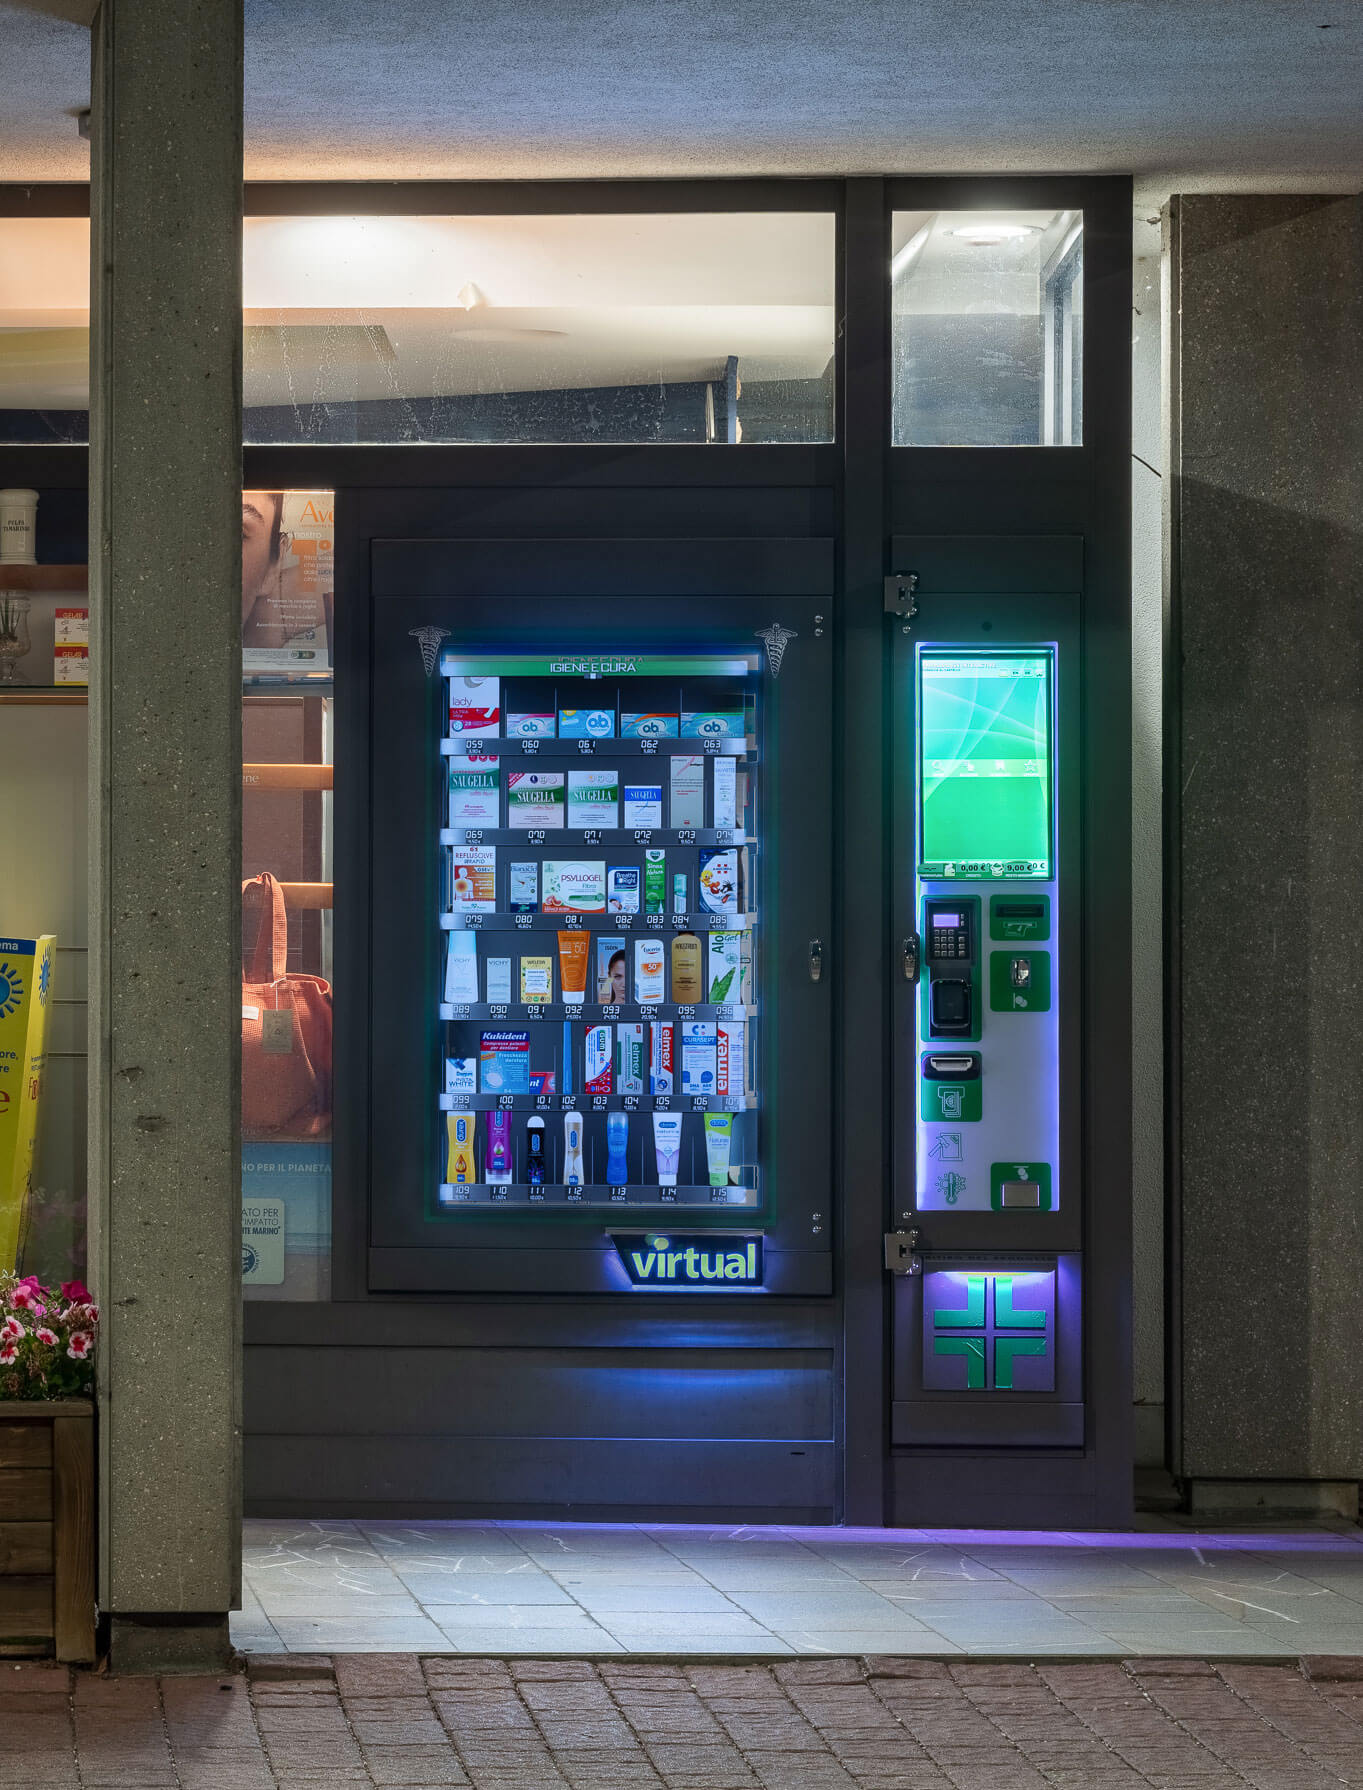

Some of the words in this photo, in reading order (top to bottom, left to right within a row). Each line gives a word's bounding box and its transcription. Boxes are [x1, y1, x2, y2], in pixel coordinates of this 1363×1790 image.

[550, 663, 588, 673] IGIENE
[591, 663, 599, 673] E
[601, 663, 636, 673] CURA
[453, 697, 472, 706] lady
[466, 740, 483, 748] 059
[522, 740, 539, 748] 060
[578, 740, 596, 748] 061
[641, 740, 658, 748] 062
[704, 740, 721, 748] 063
[453, 776, 494, 787] SAUGELLA
[517, 792, 555, 803] SAUGELLA
[574, 790, 612, 801] SAUGELLA
[465, 831, 483, 839] 069
[528, 831, 545, 839] 070
[584, 831, 602, 839] 071
[634, 831, 652, 839] 072
[678, 831, 696, 839] 073
[960, 864, 979, 872] 0,00
[561, 874, 603, 882] PSYLLOGEL
[465, 915, 483, 923] 079
[515, 915, 533, 923] 080
[565, 915, 583, 923] 081
[615, 915, 633, 923] 082
[646, 915, 664, 923] 083
[672, 915, 689, 923] 084
[710, 915, 726, 923] 085
[490, 1006, 508, 1014] 090
[528, 1006, 545, 1014] 091
[565, 1006, 583, 1014] 092
[603, 1006, 620, 1014] 093
[640, 1006, 658, 1014] 094
[678, 1006, 696, 1014] 095
[716, 1006, 733, 1014] 096
[482, 1032, 527, 1040] Kukident
[662, 1029, 672, 1067] elmex
[632, 1044, 640, 1075] elmex
[717, 1035, 728, 1091] elmex
[499, 1096, 513, 1104] 100
[537, 1096, 551, 1104] 101
[562, 1096, 576, 1104] 102
[593, 1096, 607, 1104] 103
[625, 1096, 639, 1104] 104
[656, 1096, 670, 1104] 105
[694, 1096, 708, 1104] 106
[257, 1163, 275, 1172] PER
[278, 1164, 286, 1172] IL
[288, 1164, 331, 1173] PIANETA
[493, 1186, 508, 1194] 110
[530, 1186, 545, 1194] 111
[568, 1186, 583, 1194] 112
[611, 1186, 626, 1194] 113
[661, 1186, 676, 1194] 114
[712, 1186, 726, 1194] 115
[263, 1208, 279, 1217] PER
[631, 1237, 756, 1279] virtual
